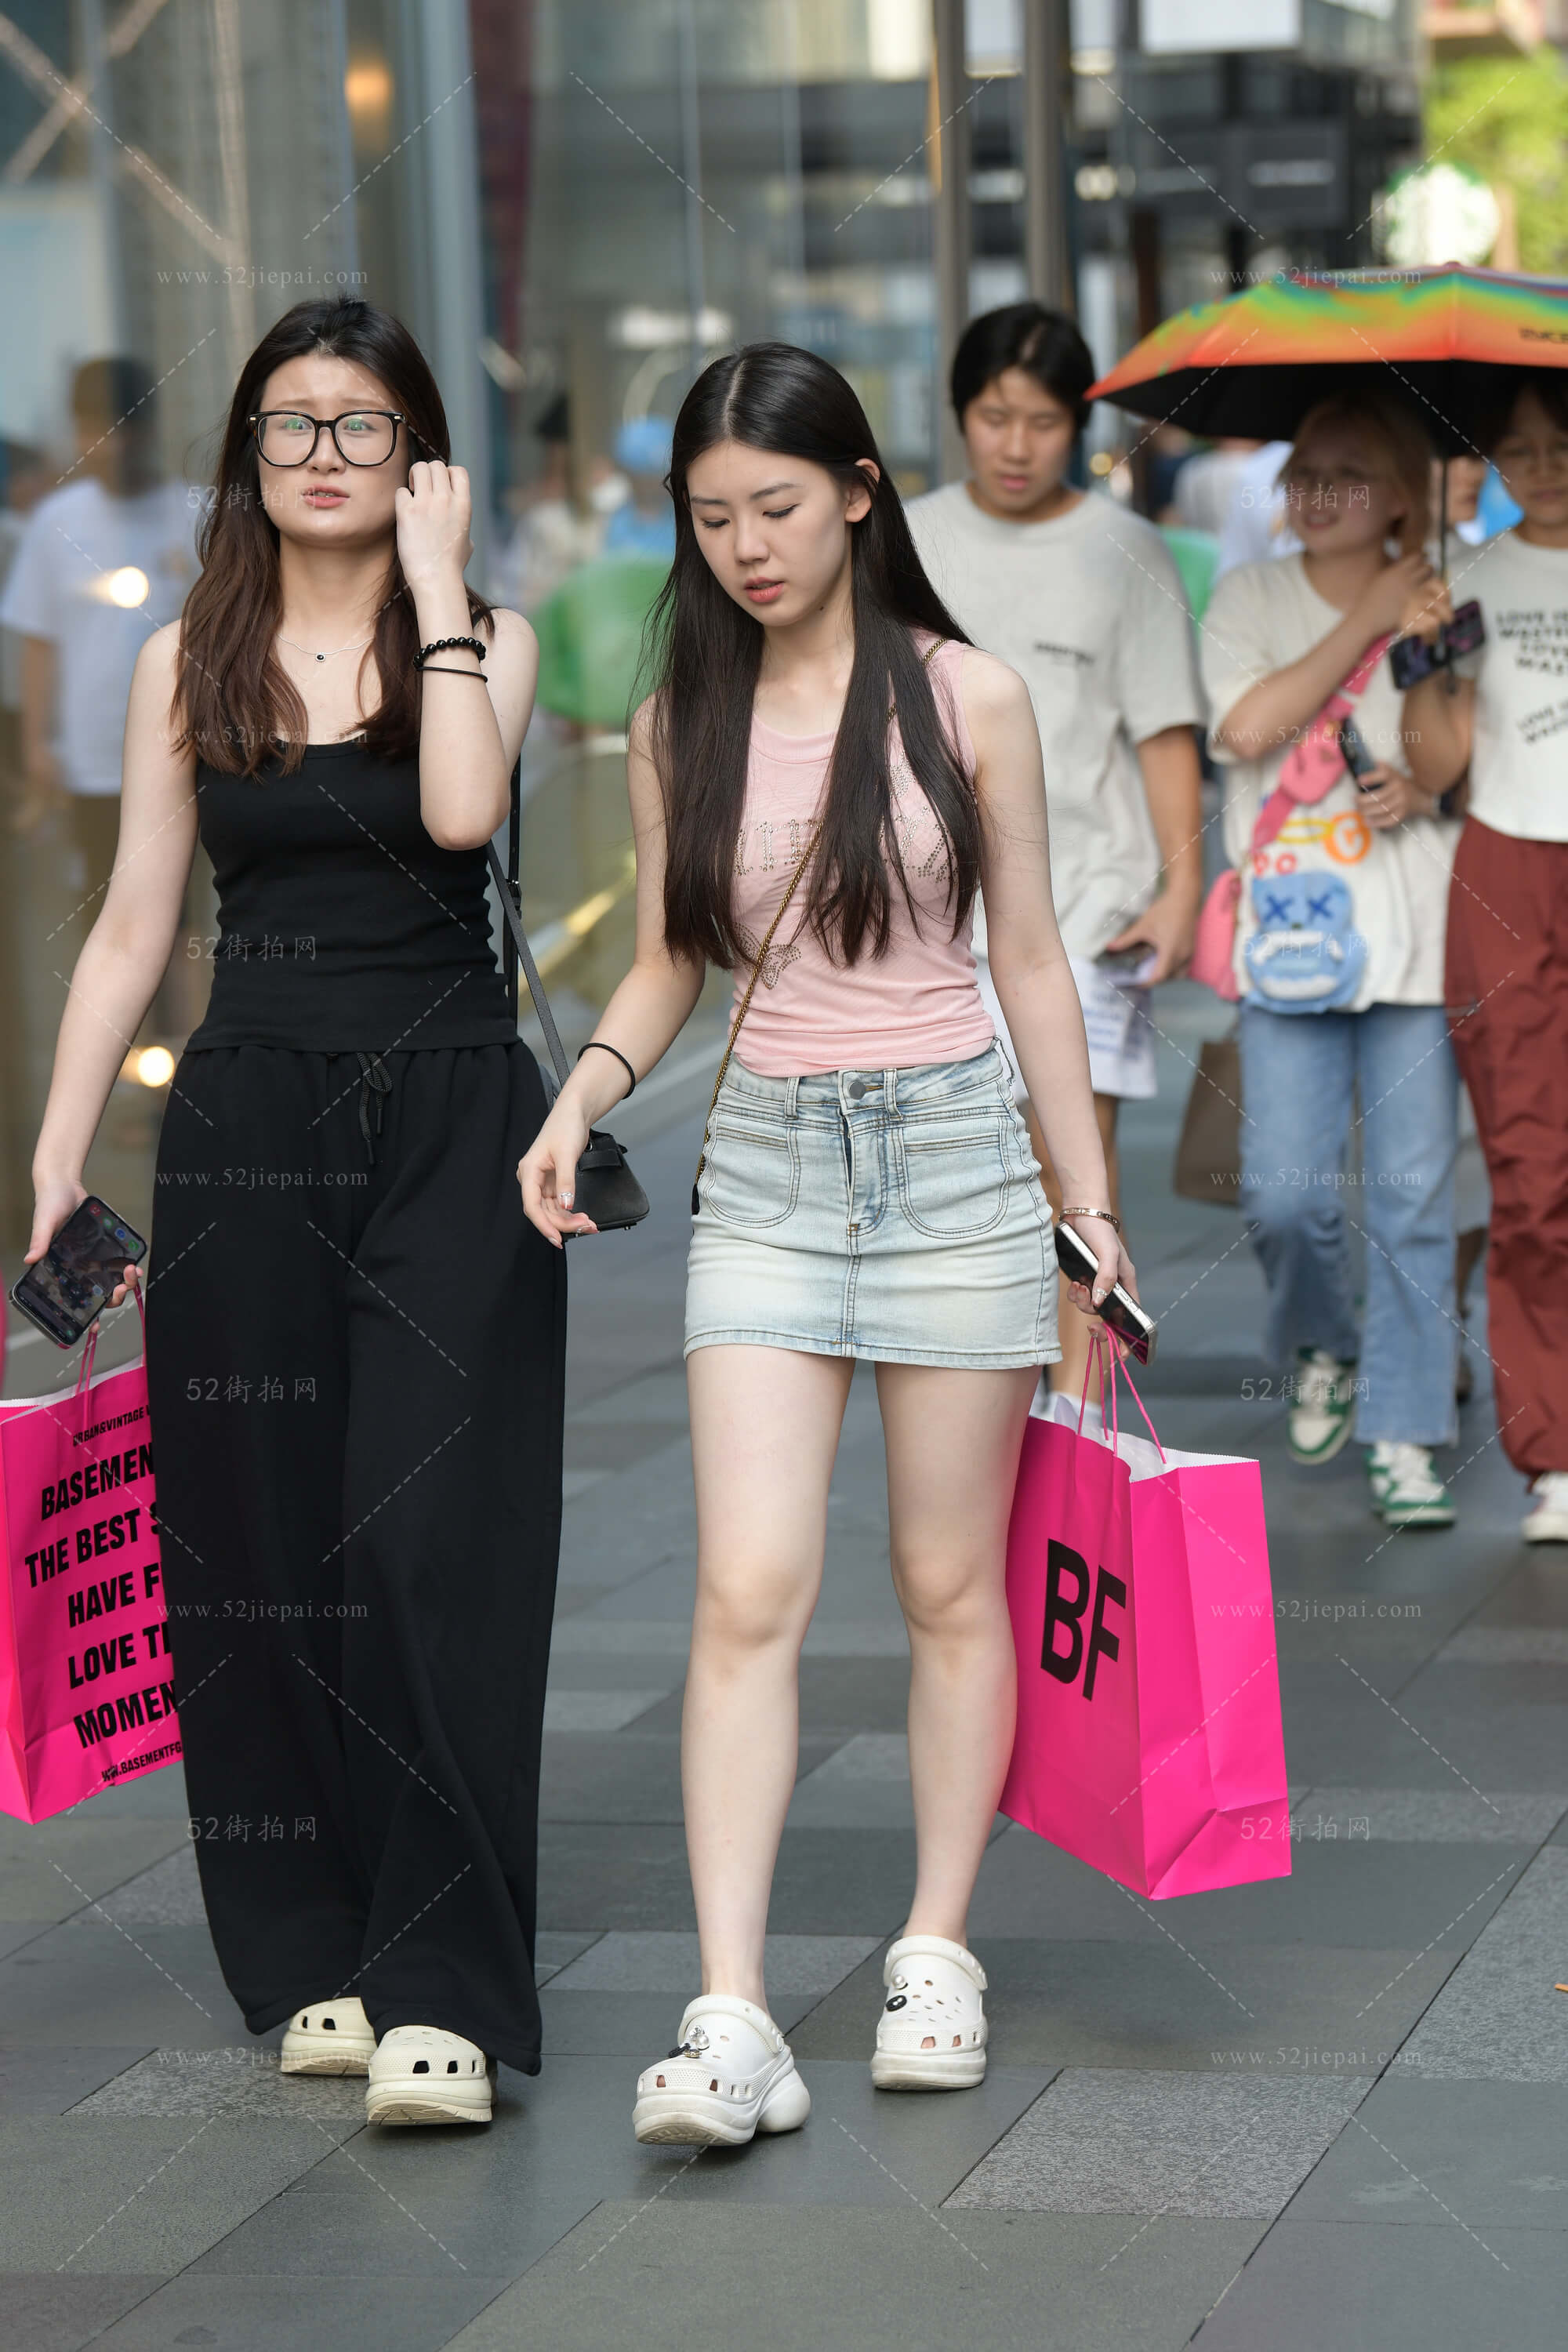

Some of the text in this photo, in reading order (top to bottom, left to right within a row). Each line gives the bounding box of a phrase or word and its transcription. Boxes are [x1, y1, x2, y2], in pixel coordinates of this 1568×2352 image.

[25, 1537, 70, 1588] THE
[76, 1508, 140, 1564] BEST
[68, 1571, 136, 1628] HAVE
[1040, 1537, 1127, 1703] BF
[68, 1633, 136, 1690] LOVE
